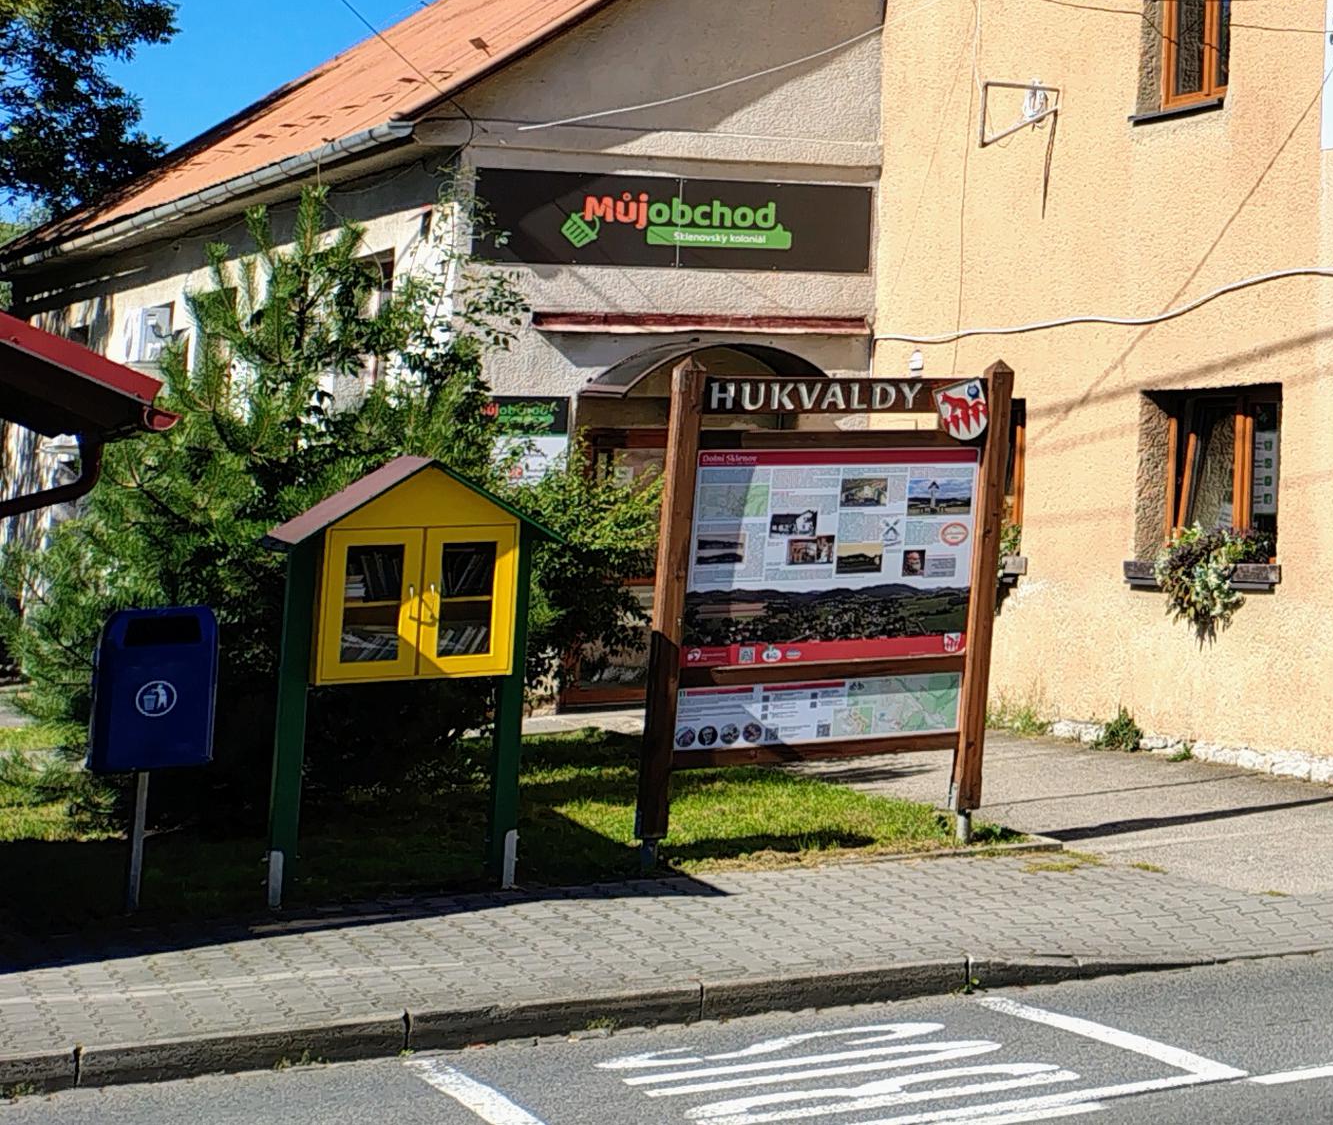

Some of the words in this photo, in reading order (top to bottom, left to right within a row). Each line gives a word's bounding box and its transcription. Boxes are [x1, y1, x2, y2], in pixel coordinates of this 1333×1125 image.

[583, 192, 777, 229] Můjobchod
[673, 231, 728, 244] Sklenovský
[729, 234, 766, 244] koloniál
[710, 382, 923, 411] HUKVALDY
